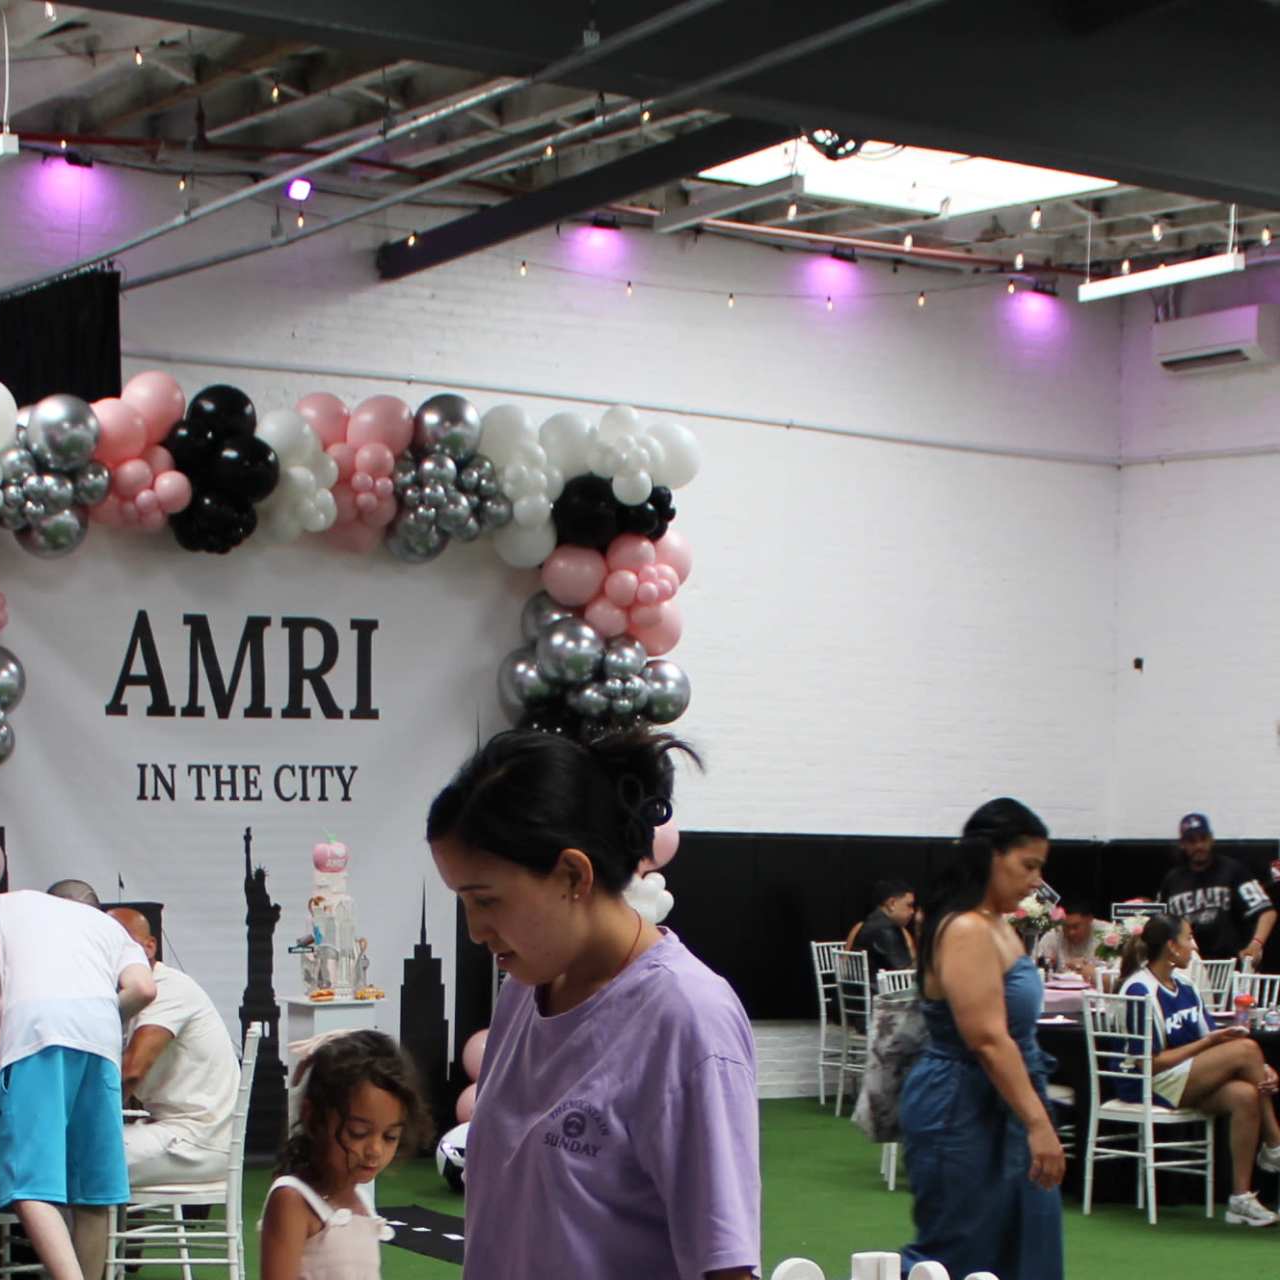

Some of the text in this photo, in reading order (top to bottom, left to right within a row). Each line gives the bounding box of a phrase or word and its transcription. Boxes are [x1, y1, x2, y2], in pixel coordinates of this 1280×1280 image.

[105, 610, 380, 720] AMRI
[136, 763, 358, 802] IN THE CITY
[544, 1131, 602, 1158] SUNDAY
